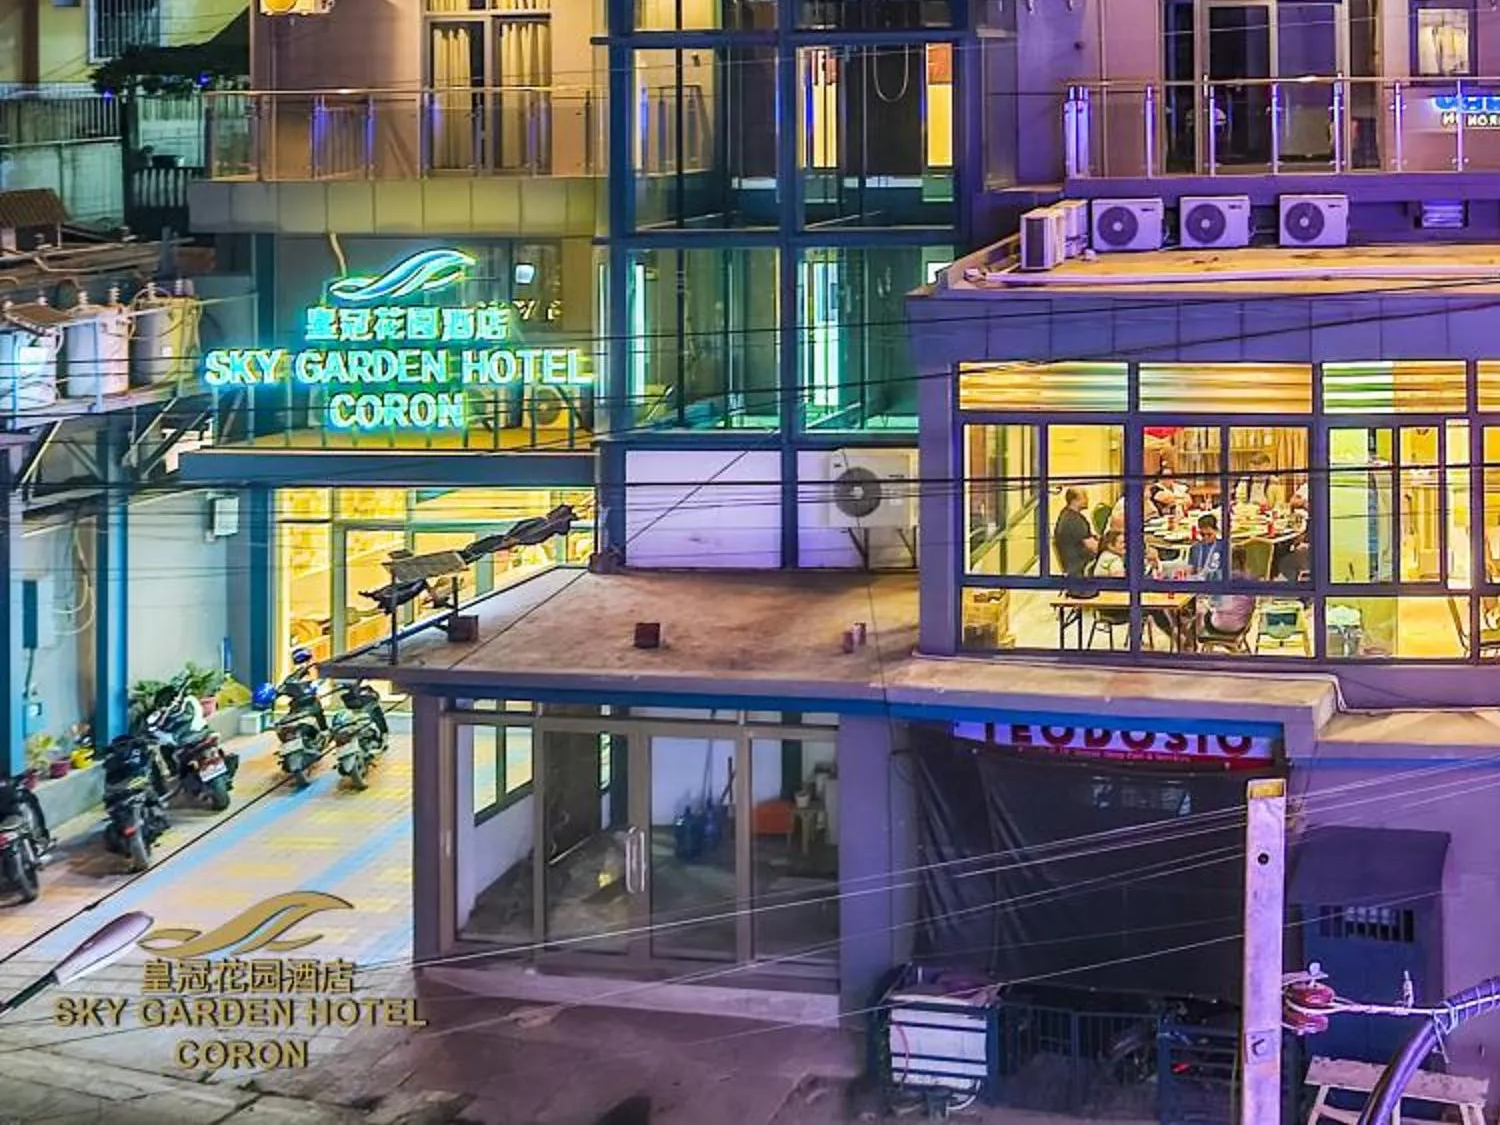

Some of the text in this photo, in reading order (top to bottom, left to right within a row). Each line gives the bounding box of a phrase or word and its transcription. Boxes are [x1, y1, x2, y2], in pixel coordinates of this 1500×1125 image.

[205, 349, 593, 385] SKY GARDEN HOTEL
[329, 392, 466, 429] CORON
